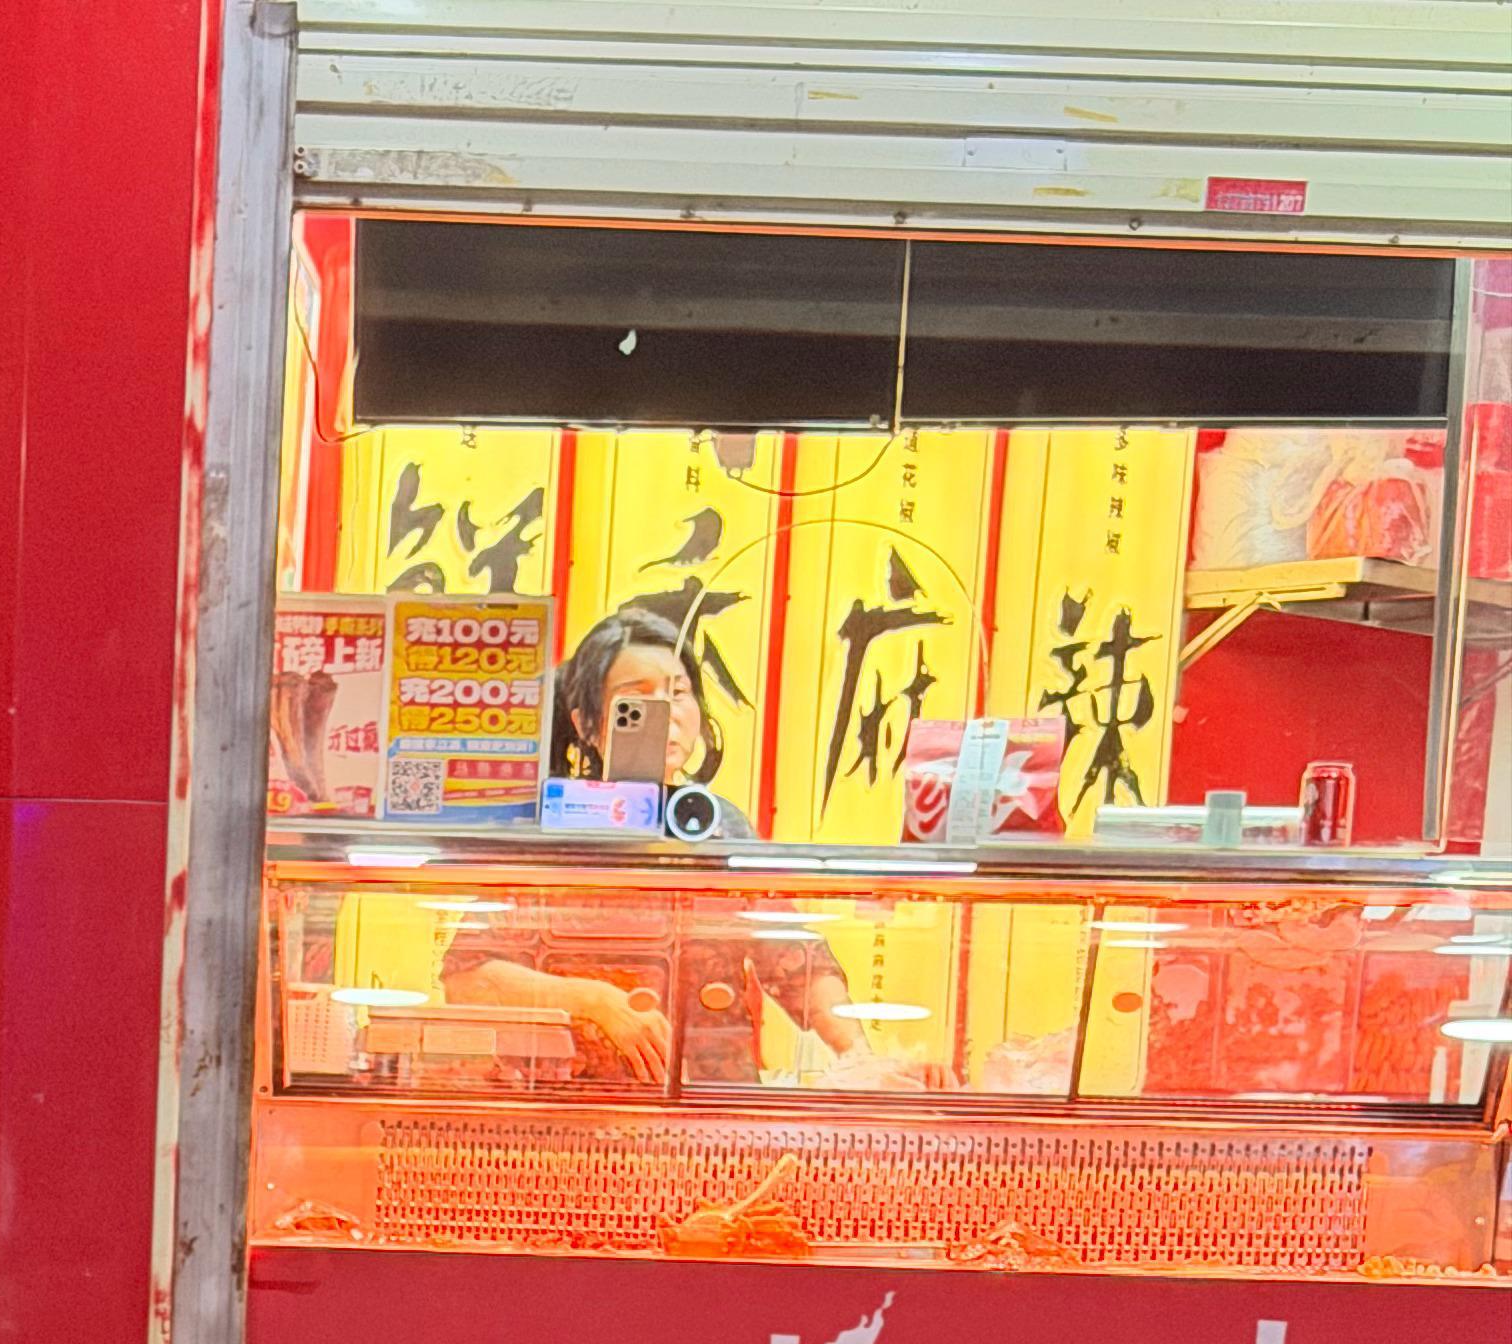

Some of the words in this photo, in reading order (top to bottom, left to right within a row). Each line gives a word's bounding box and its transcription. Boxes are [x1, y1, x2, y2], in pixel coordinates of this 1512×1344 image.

[406, 617, 540, 644] 充100元
[274, 636, 383, 674] 磅上新
[406, 646, 538, 673] 得120元
[399, 678, 540, 705] 充200元
[399, 706, 537, 733] 得250元
